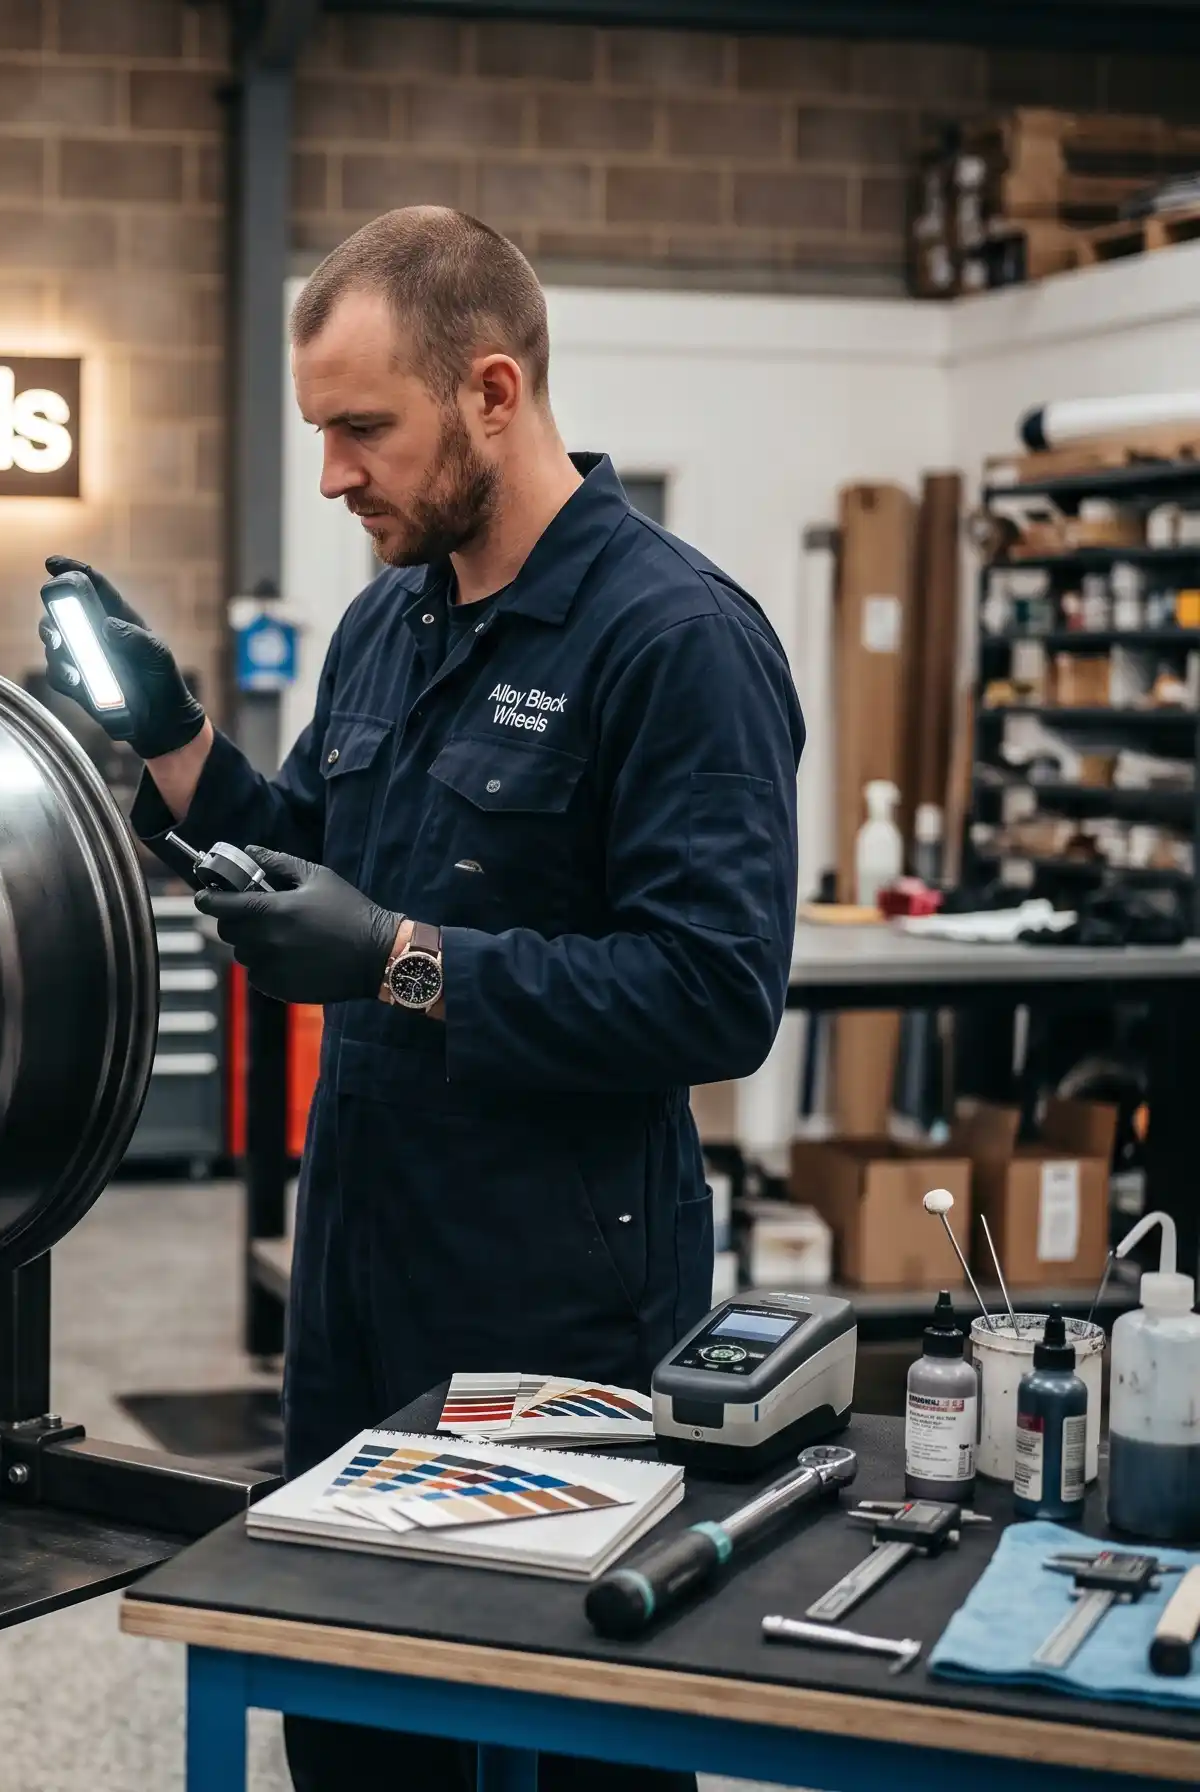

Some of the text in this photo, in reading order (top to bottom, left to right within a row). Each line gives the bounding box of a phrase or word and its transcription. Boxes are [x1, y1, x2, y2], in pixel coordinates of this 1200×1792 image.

[488, 683, 568, 713] Alloy Black
[493, 704, 548, 732] Wheels
